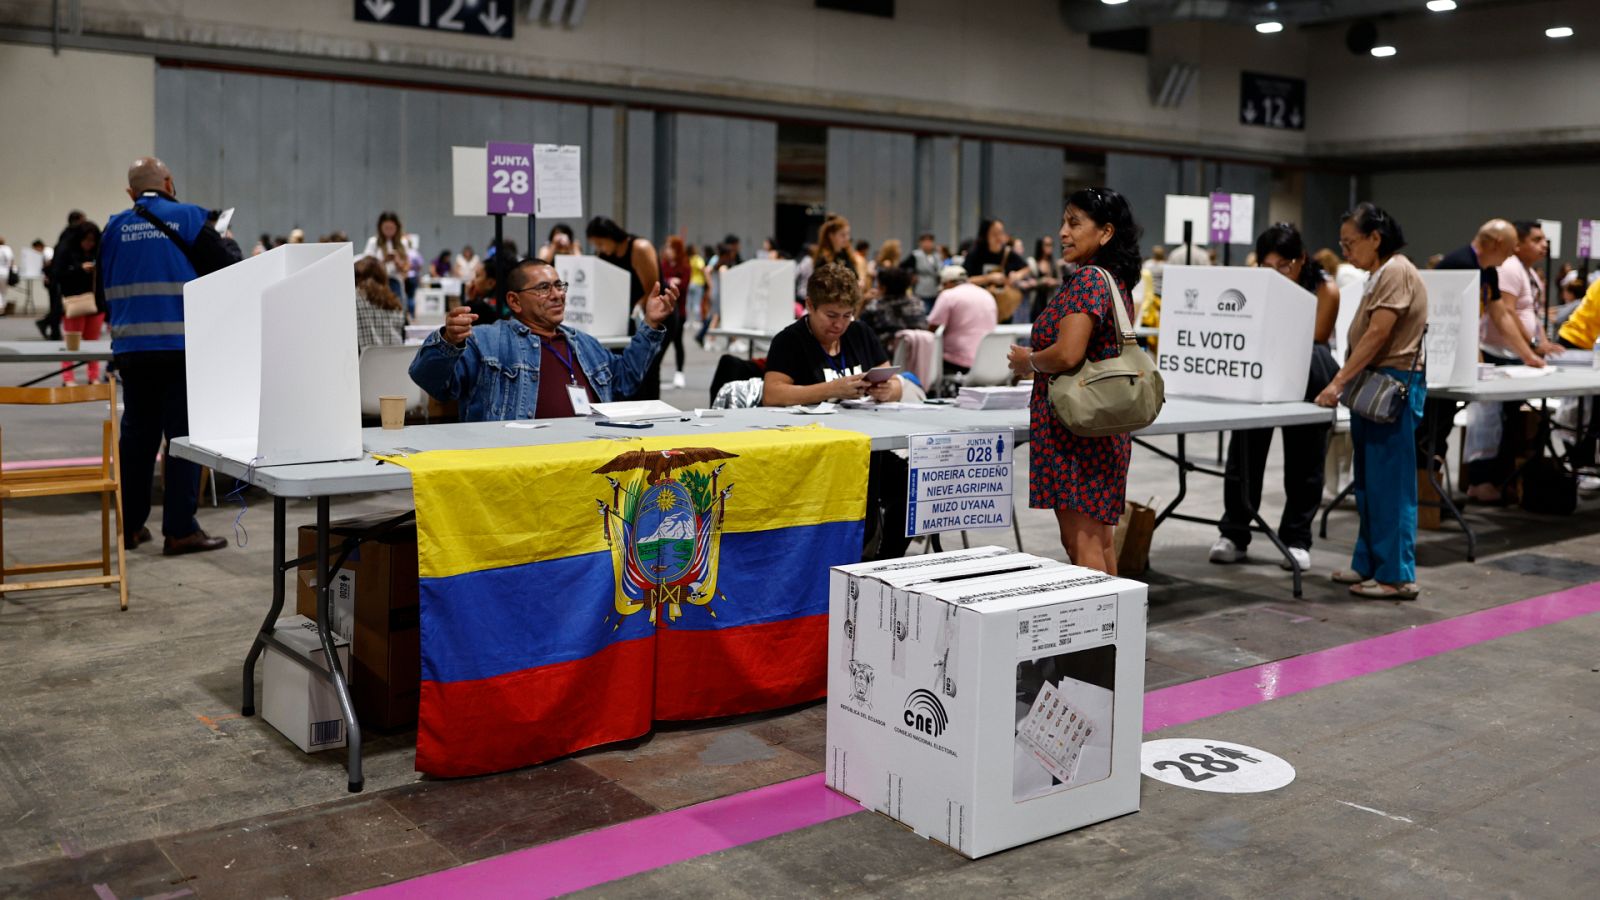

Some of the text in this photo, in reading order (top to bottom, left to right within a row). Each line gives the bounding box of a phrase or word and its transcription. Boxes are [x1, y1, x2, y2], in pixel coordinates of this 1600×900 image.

[1262, 96, 1286, 128] 12
[491, 155, 530, 167] JUNTA
[492, 169, 529, 195] 28
[1177, 330, 1246, 351] EL VOTO
[1159, 354, 1263, 380] ES SECRETO
[966, 439, 986, 447] JUNTA
[967, 447, 992, 463] 028
[922, 465, 1008, 482] MOREIRA CEDEÑO
[926, 482, 1003, 497] NIEVE AGRIPINA
[932, 499, 995, 514] MUZO UYANA
[922, 513, 1003, 530] MARTHA CECILIA
[903, 709, 933, 735] CNE
[893, 726, 958, 758] CONSEJO NACIONAL ELECTORAL
[1152, 752, 1239, 783] 28
